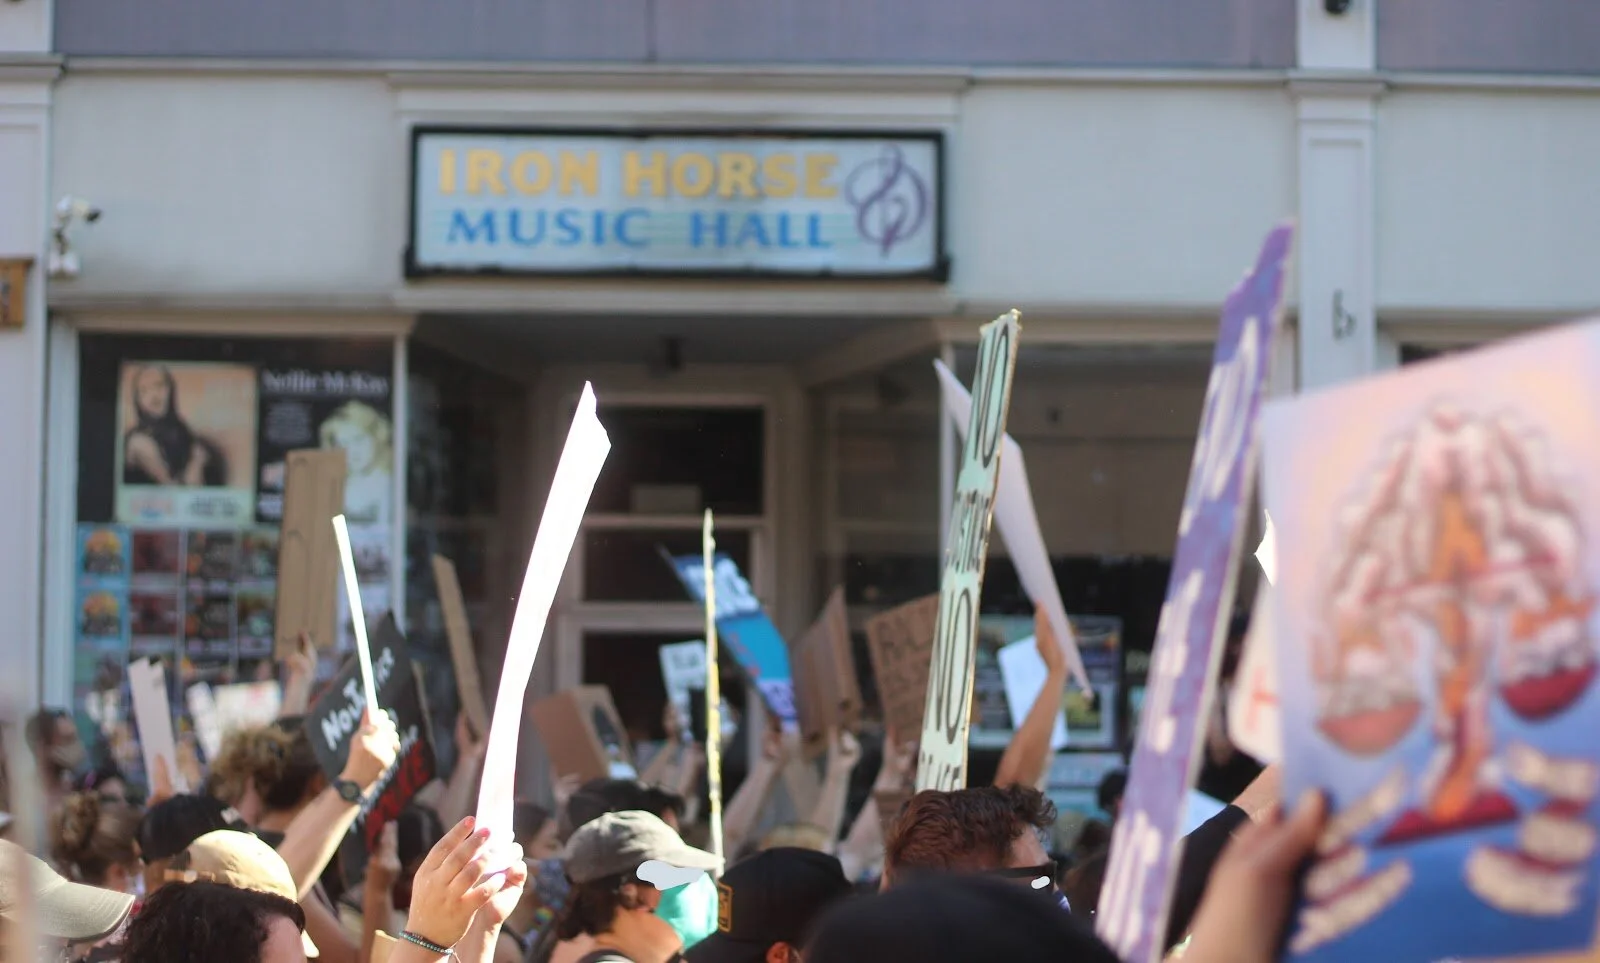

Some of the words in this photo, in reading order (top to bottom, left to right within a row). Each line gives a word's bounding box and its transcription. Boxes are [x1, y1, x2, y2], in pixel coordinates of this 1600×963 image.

[437, 147, 598, 197] IRON
[622, 149, 840, 200] HORSE
[446, 206, 652, 249] MUSIC
[689, 211, 834, 250] HALL
